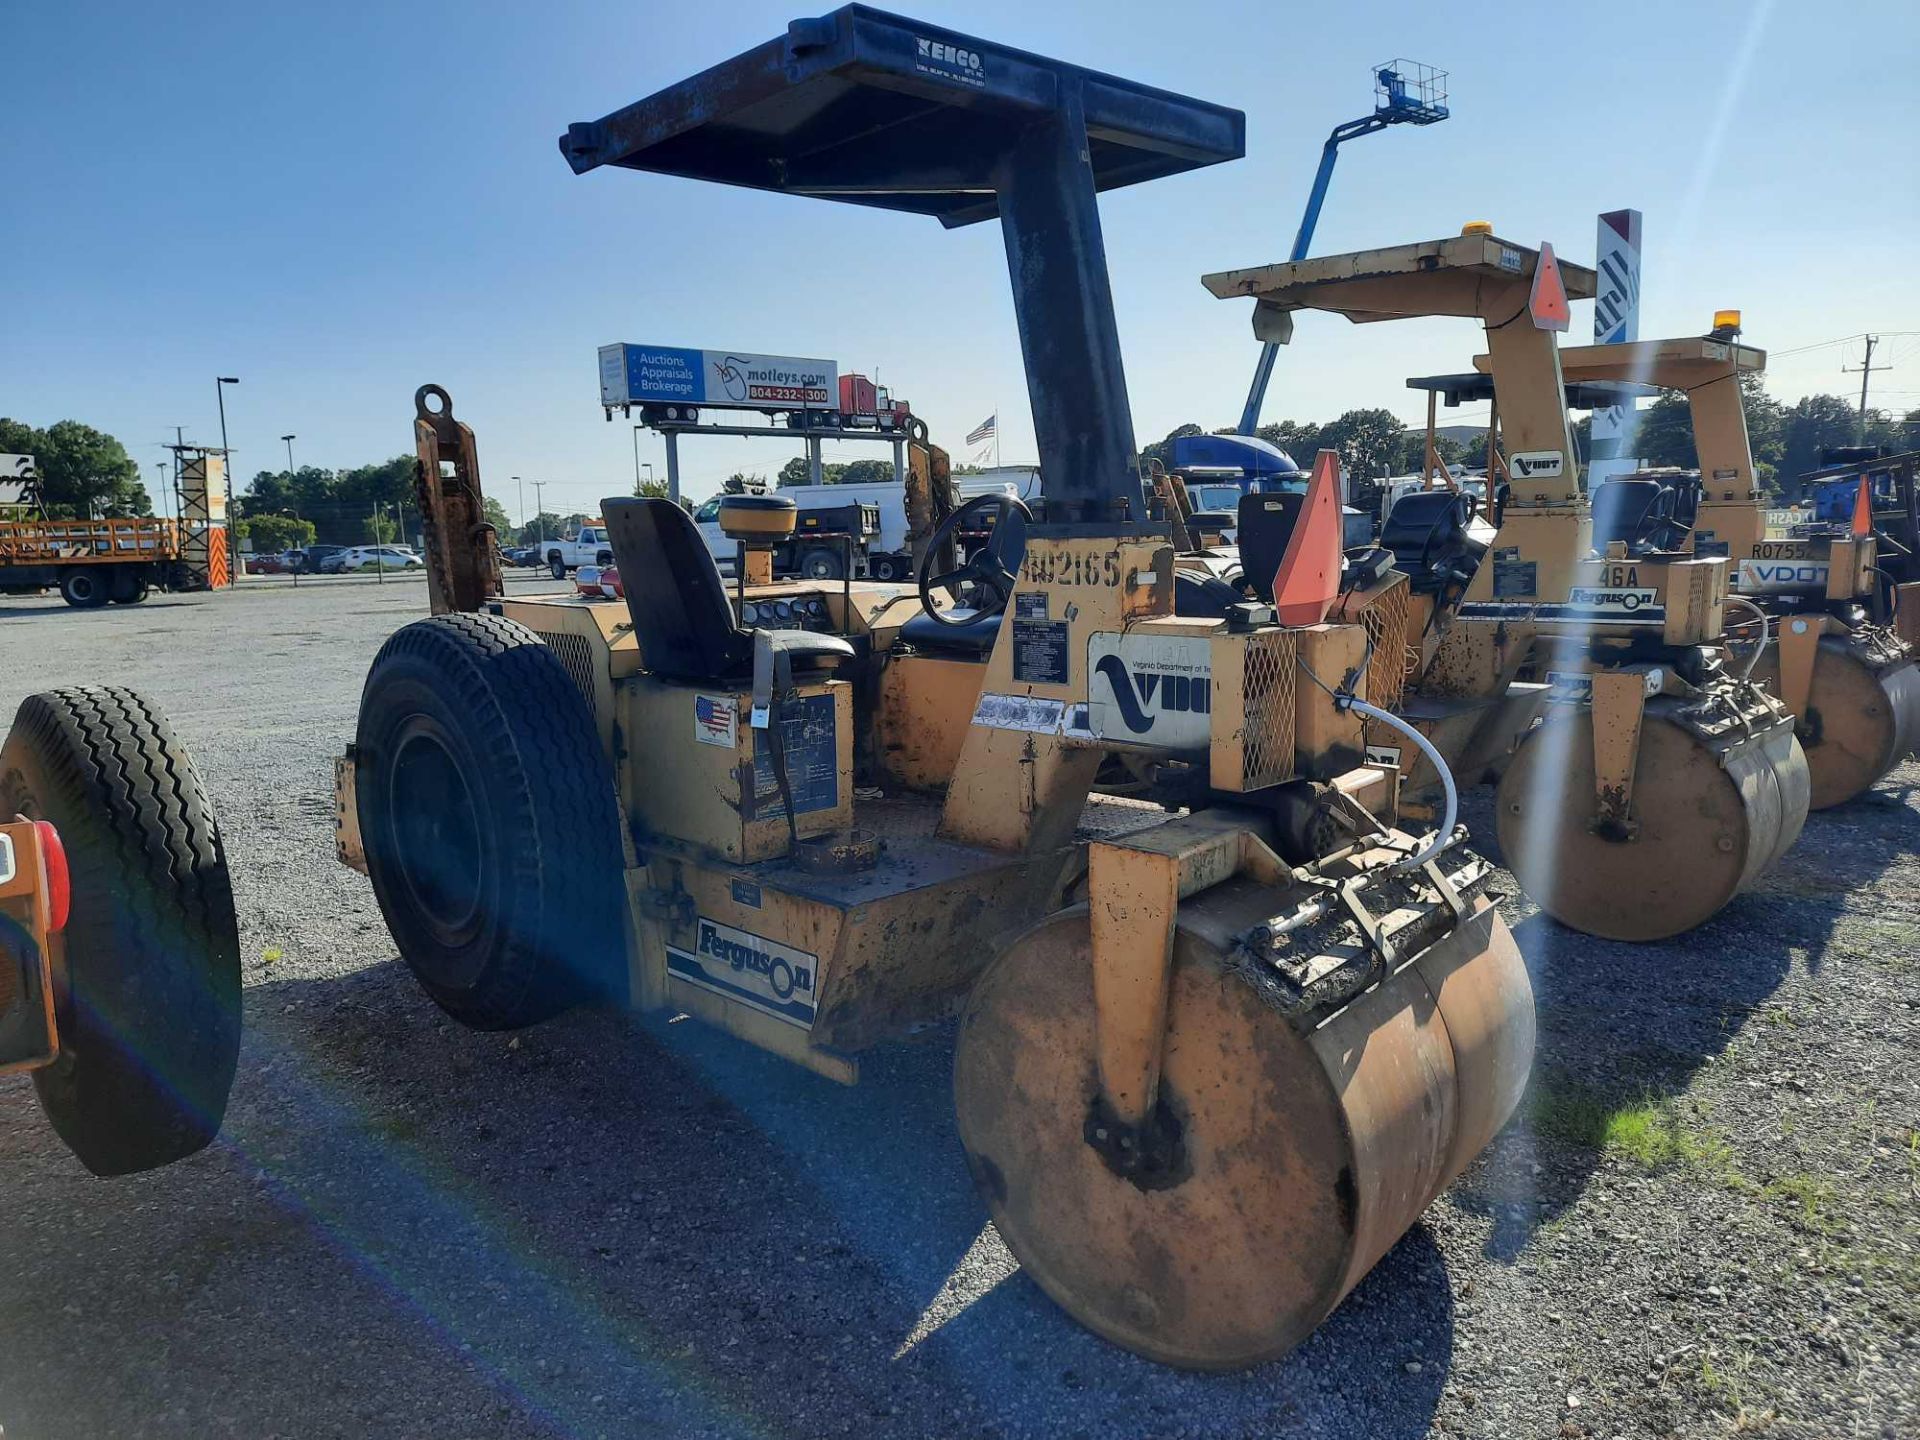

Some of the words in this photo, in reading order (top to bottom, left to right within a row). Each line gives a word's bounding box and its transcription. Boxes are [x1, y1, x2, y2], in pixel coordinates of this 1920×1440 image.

[640, 353, 685, 366] Auctions
[641, 366, 693, 380] Appraisals
[748, 368, 826, 386] motleys.com
[641, 379, 693, 395] Brokerage
[1132, 660, 1156, 670] Virginia
[1156, 662, 1193, 673] Department
[1194, 665, 1202, 673] of
